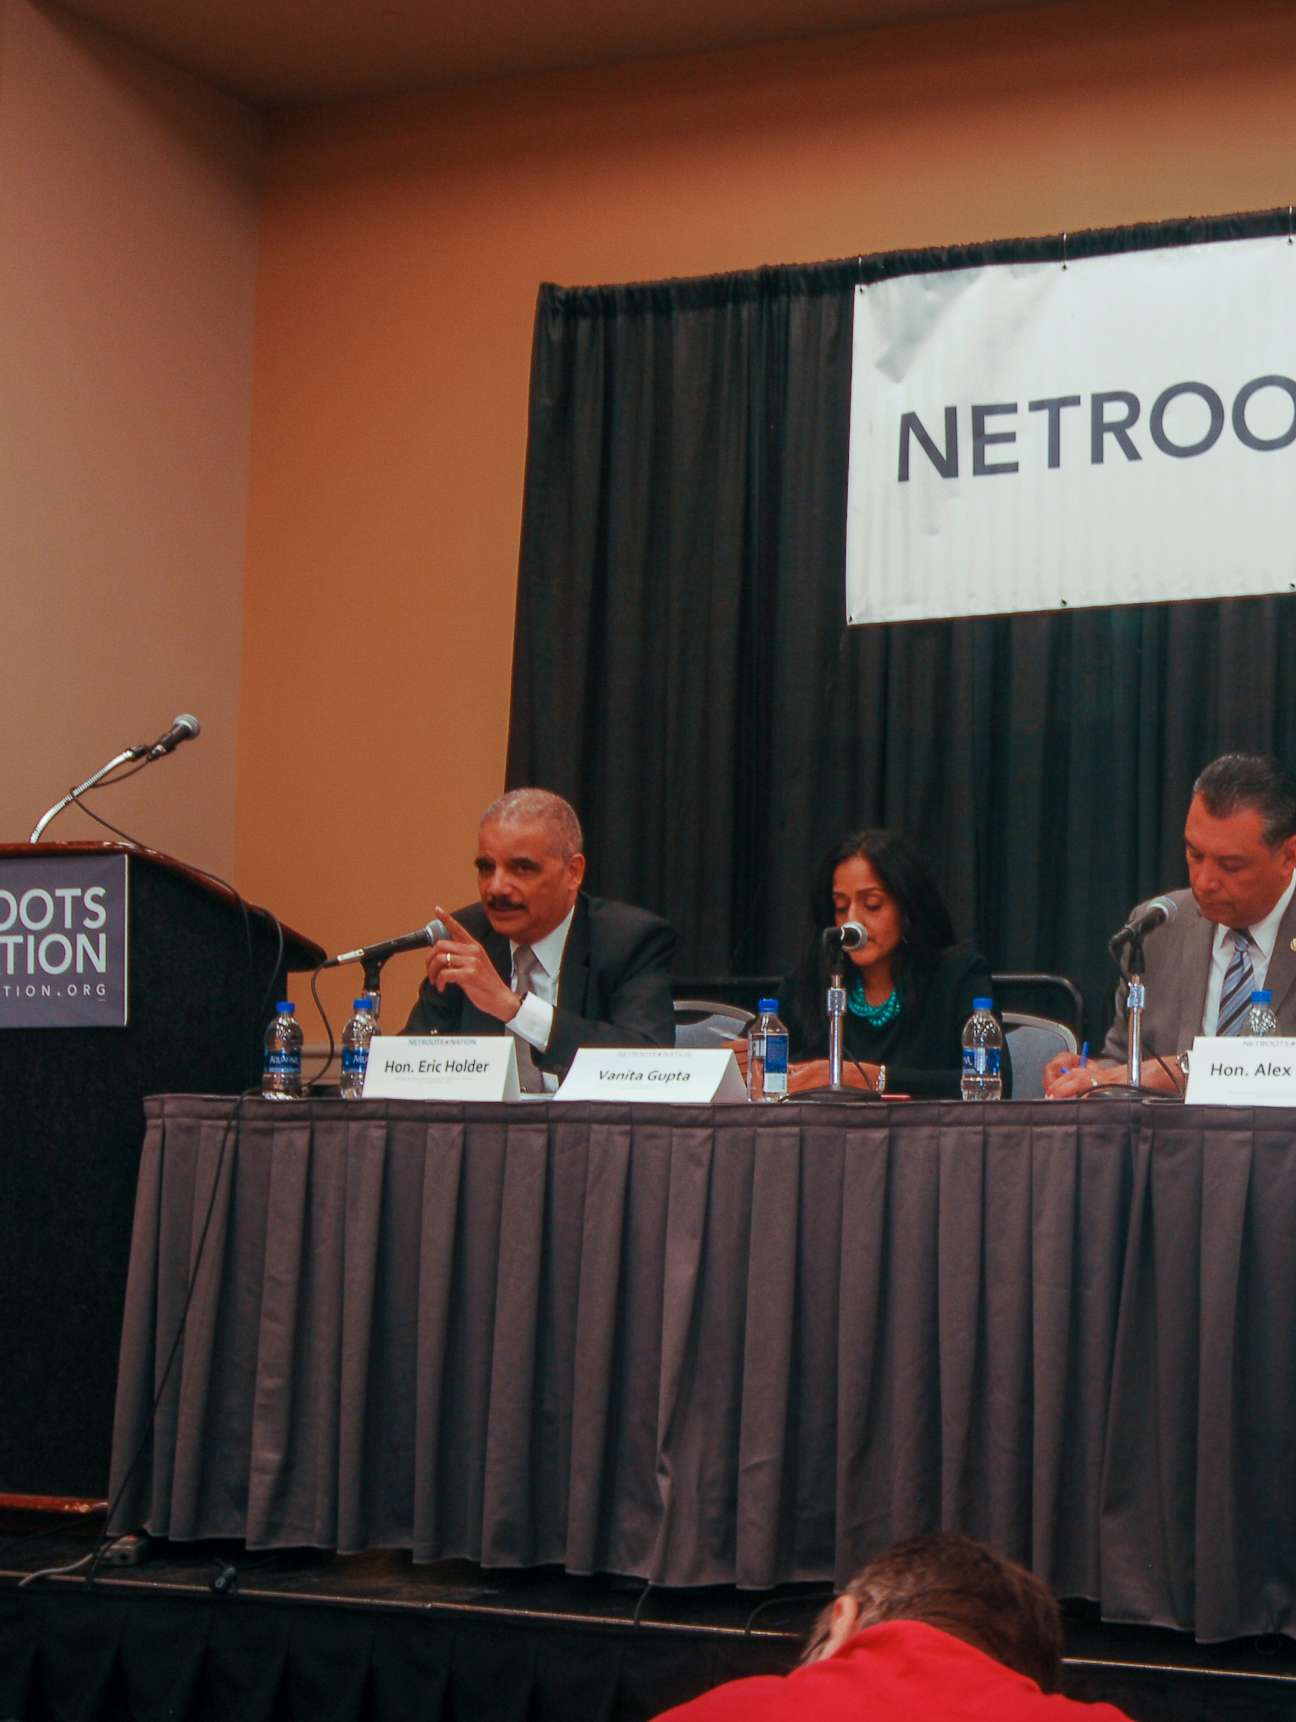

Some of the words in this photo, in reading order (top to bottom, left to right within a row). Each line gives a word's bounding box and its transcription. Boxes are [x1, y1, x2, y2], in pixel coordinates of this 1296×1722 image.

[385, 1060, 414, 1073] Hon.
[418, 1059, 442, 1073] Eric
[445, 1058, 490, 1073] Holder
[1210, 1063, 1249, 1077] Hon.
[1254, 1063, 1291, 1077] Alex
[598, 1070, 643, 1081] Vanita
[647, 1070, 690, 1083] Gupta
